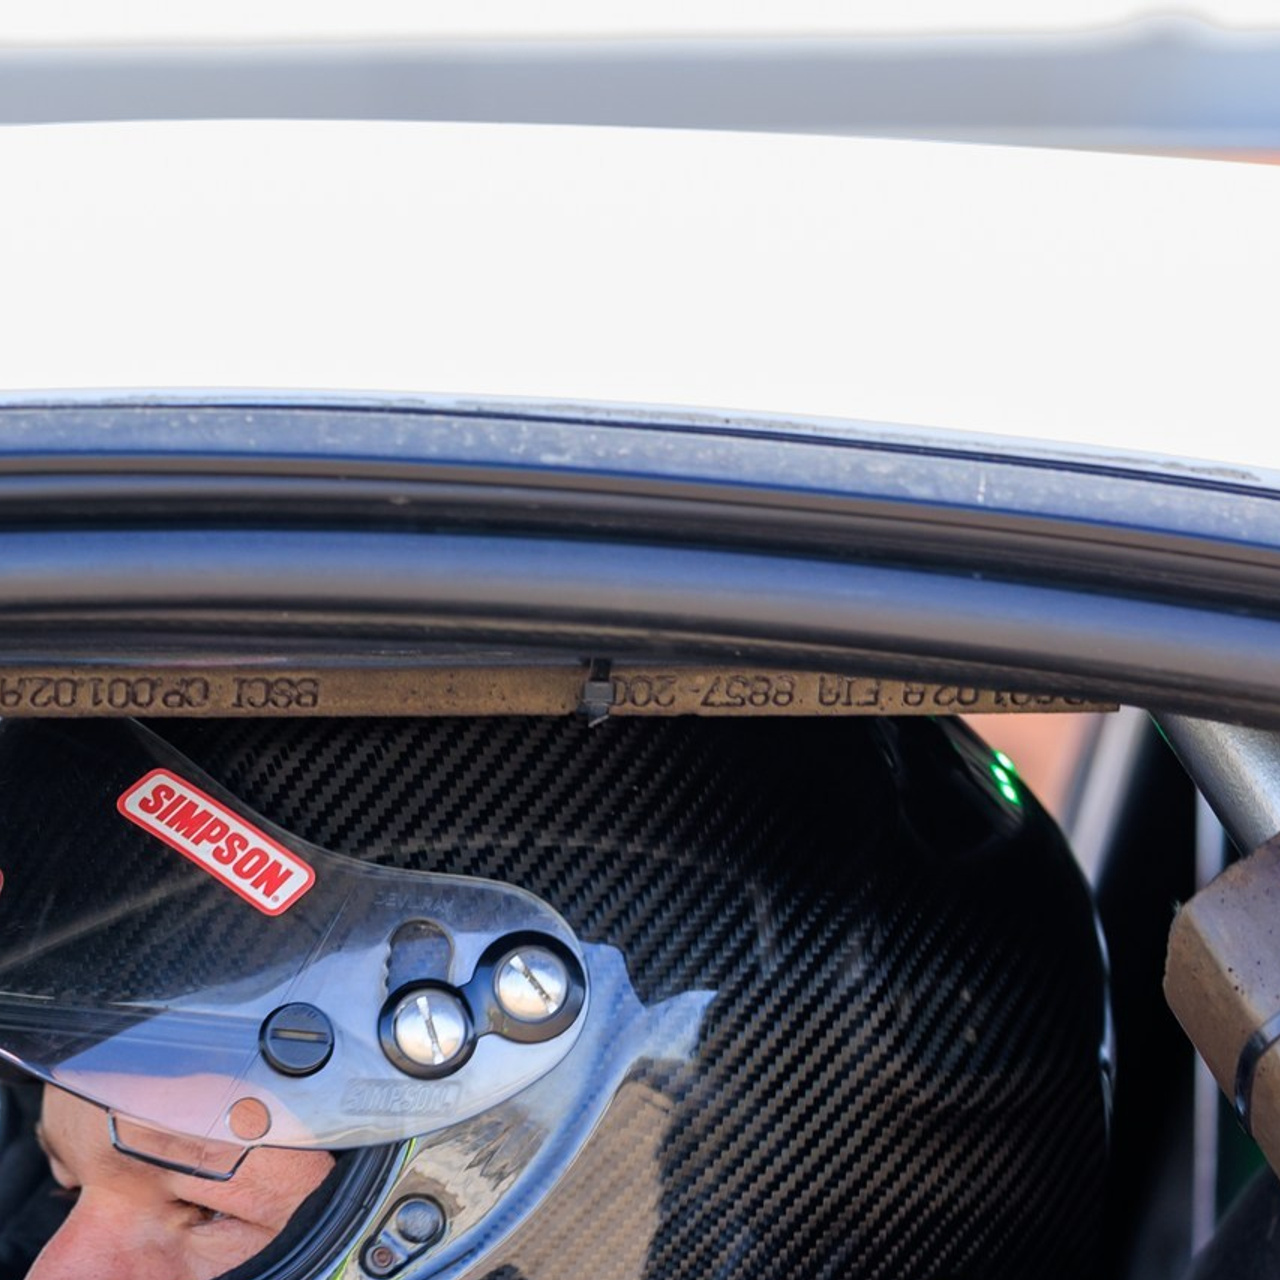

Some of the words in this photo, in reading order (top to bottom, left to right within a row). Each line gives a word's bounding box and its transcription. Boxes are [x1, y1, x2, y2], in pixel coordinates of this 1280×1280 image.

[231, 677, 320, 708] BSCI
[605, 675, 796, 707] 8857-200
[818, 676, 881, 708] FIA
[138, 783, 295, 899] SIMPSON
